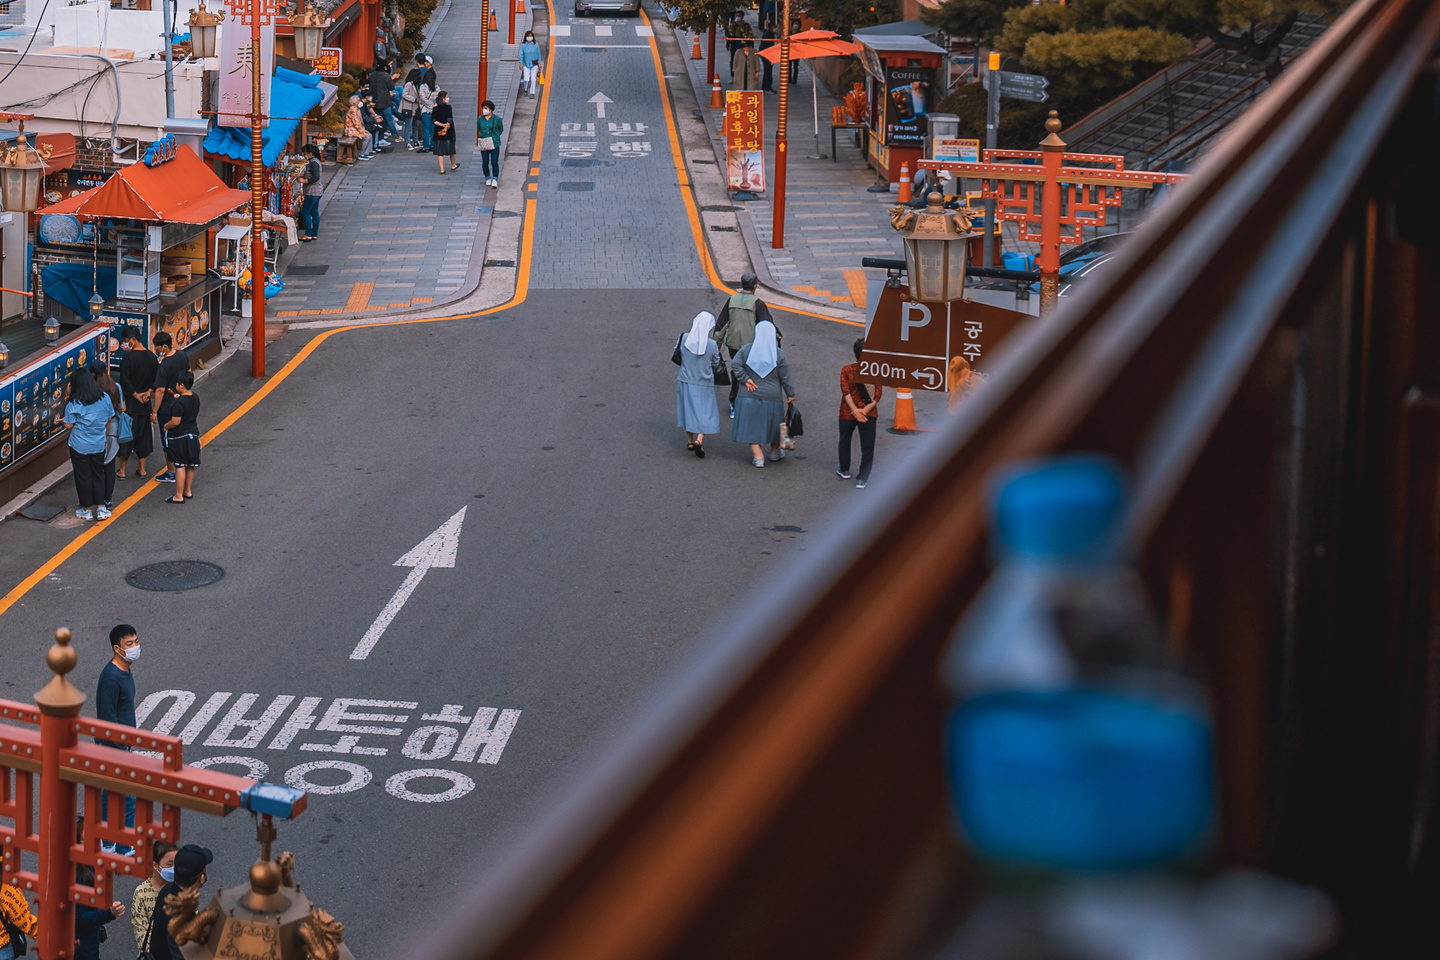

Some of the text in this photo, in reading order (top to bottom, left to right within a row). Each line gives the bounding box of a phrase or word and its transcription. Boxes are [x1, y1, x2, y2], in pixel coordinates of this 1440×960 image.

[730, 104, 744, 152] 탕후루
[746, 94, 760, 153] 과일사탕
[901, 302, 932, 341] P
[859, 361, 906, 380] 200m
